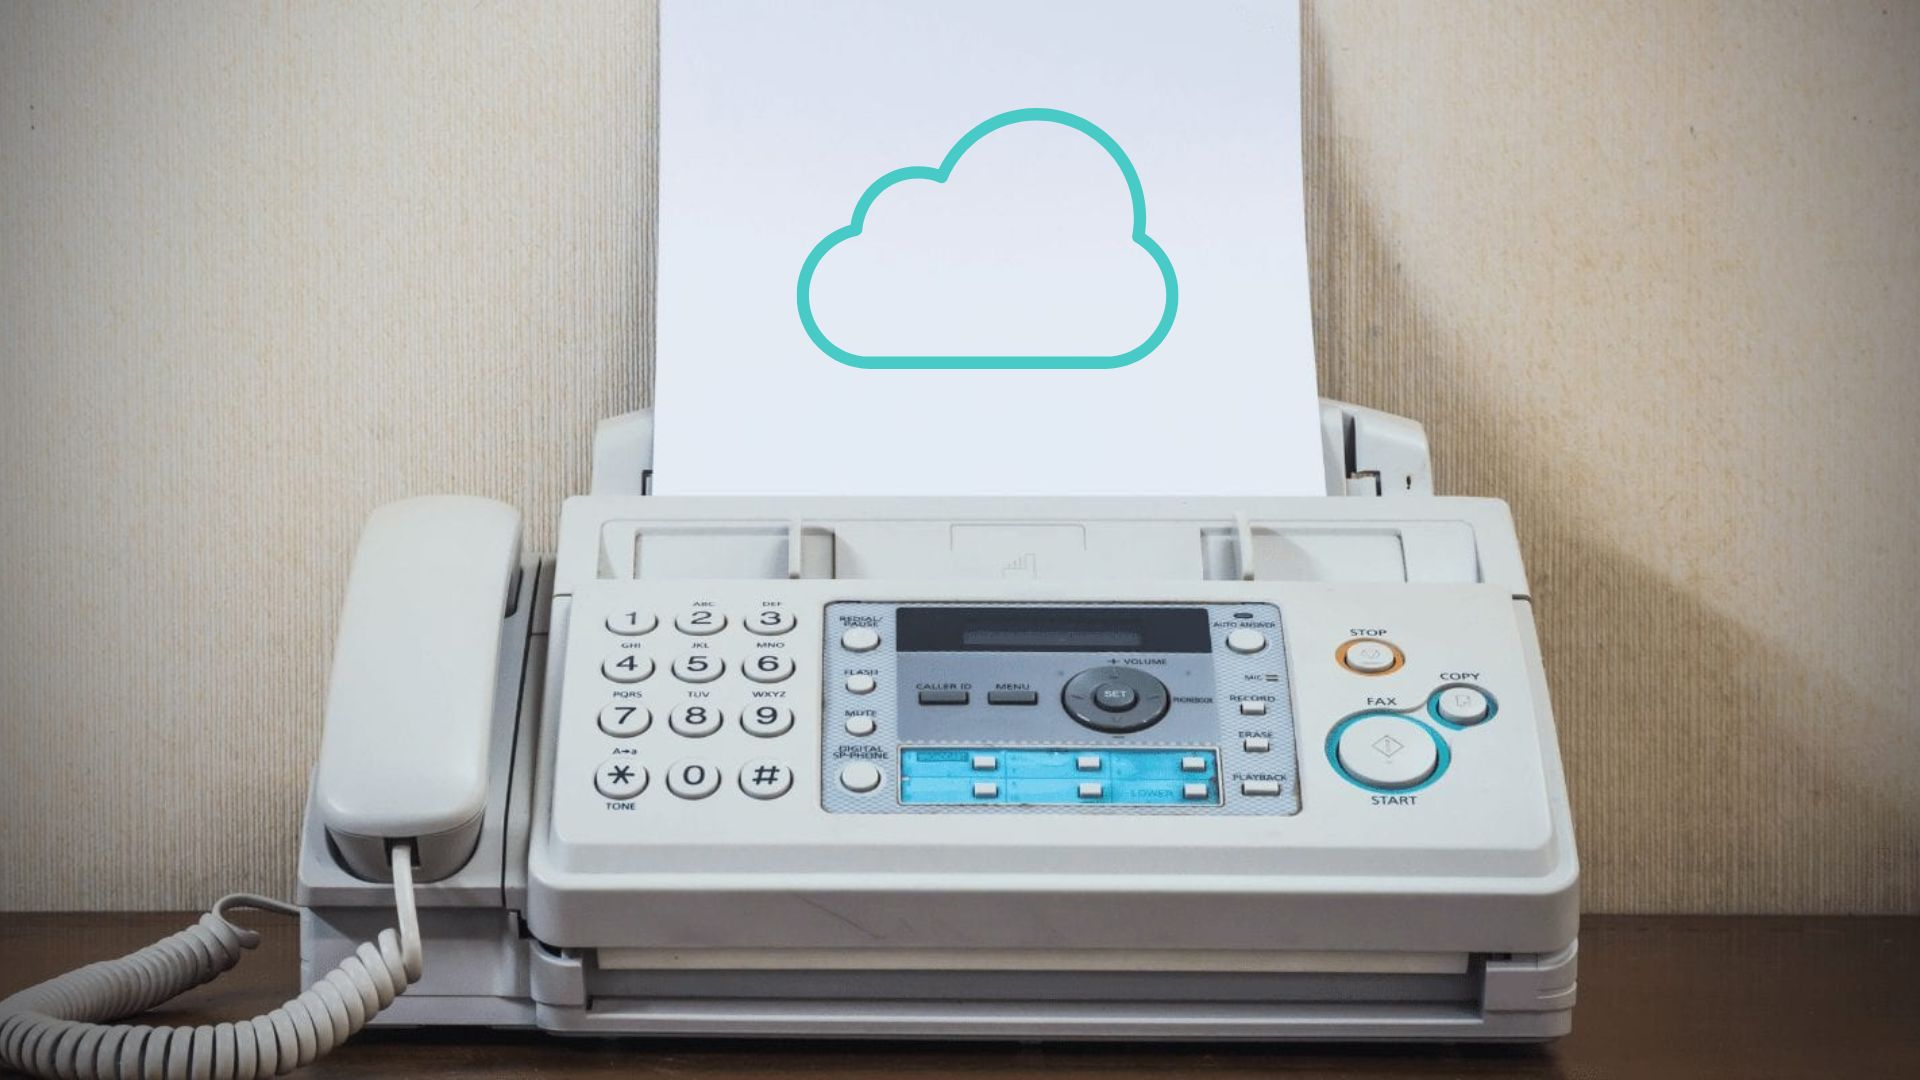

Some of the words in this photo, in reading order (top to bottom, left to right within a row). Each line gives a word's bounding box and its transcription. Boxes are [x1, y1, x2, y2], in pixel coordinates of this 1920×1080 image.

[625, 611, 637, 625] 1
[690, 611, 712, 625] 2
[760, 611, 782, 625] 3
[1350, 628, 1387, 636] STOP
[616, 655, 638, 672] 4
[687, 655, 709, 672] 5
[757, 655, 779, 672] 6
[1440, 672, 1481, 681] COPY
[960, 682, 972, 690] ID
[612, 690, 643, 699] PQRS
[688, 690, 710, 698] TUV
[752, 690, 787, 698] WXYZ
[1104, 690, 1127, 698] SET
[1229, 694, 1276, 703] RECORD
[1367, 697, 1397, 706] FAX
[614, 706, 637, 725] 7
[685, 706, 707, 725] 8
[756, 706, 778, 725] 9
[844, 709, 878, 717] MUTE
[682, 764, 706, 785] 0
[752, 765, 781, 785] #
[1371, 795, 1418, 805] START
[606, 802, 637, 811] TONE
